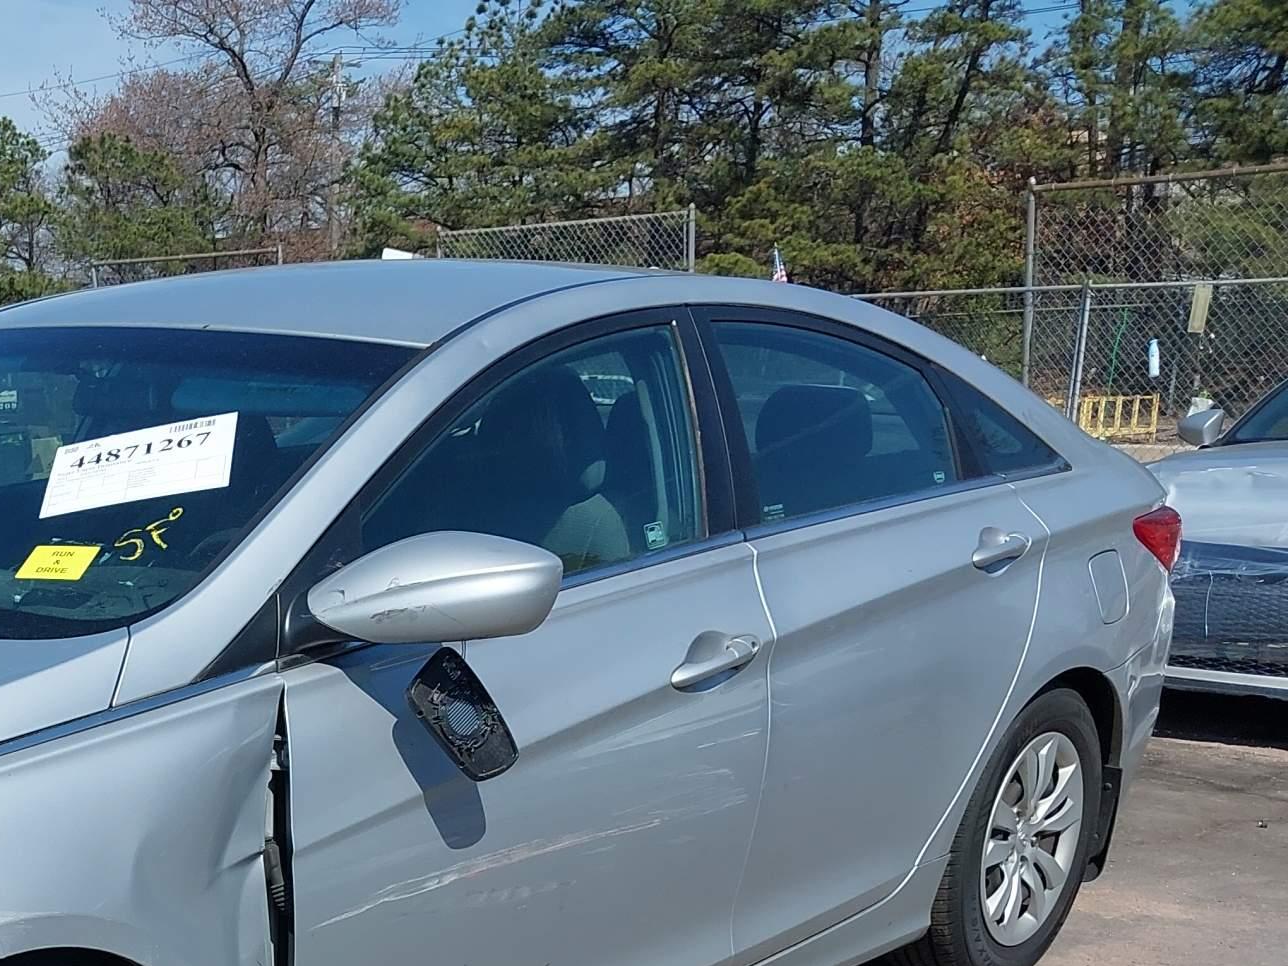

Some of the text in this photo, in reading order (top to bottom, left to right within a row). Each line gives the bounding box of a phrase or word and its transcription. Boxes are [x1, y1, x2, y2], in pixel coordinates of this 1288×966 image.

[69, 431, 212, 469] 44871267
[52, 550, 75, 558] RUN
[35, 566, 69, 574] DRIVE
